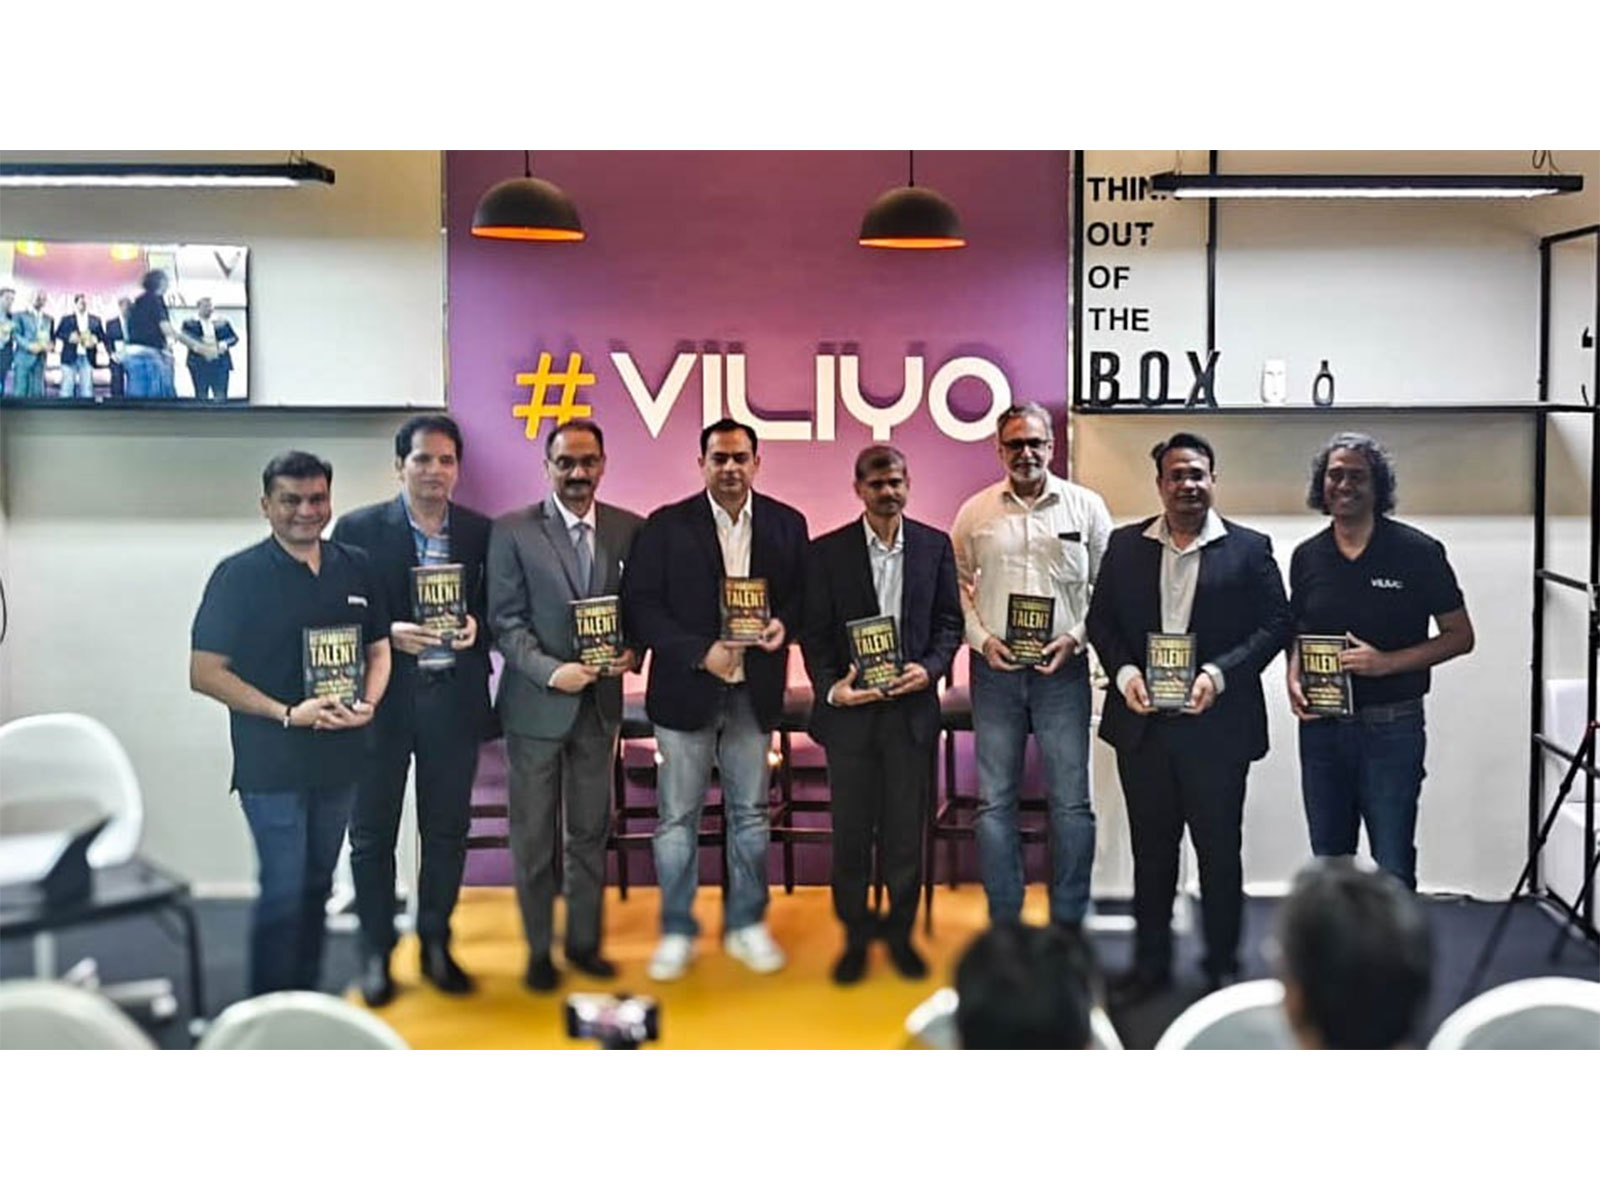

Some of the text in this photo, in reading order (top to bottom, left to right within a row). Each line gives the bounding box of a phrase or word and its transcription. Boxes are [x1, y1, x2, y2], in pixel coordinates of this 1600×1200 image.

[1087, 177, 1182, 201] THIN
[1086, 222, 1154, 246] OUT
[1088, 266, 1130, 289] OF
[1088, 308, 1150, 331] THE
[1090, 350, 1221, 407] BOX
[418, 583, 460, 605] TALENT
[726, 591, 765, 608] TALENT
[576, 613, 617, 635] TALENT
[1012, 610, 1050, 629] TALENT
[310, 642, 357, 667] TALENT
[854, 632, 895, 657] TALENT
[1151, 650, 1190, 667] TALENT
